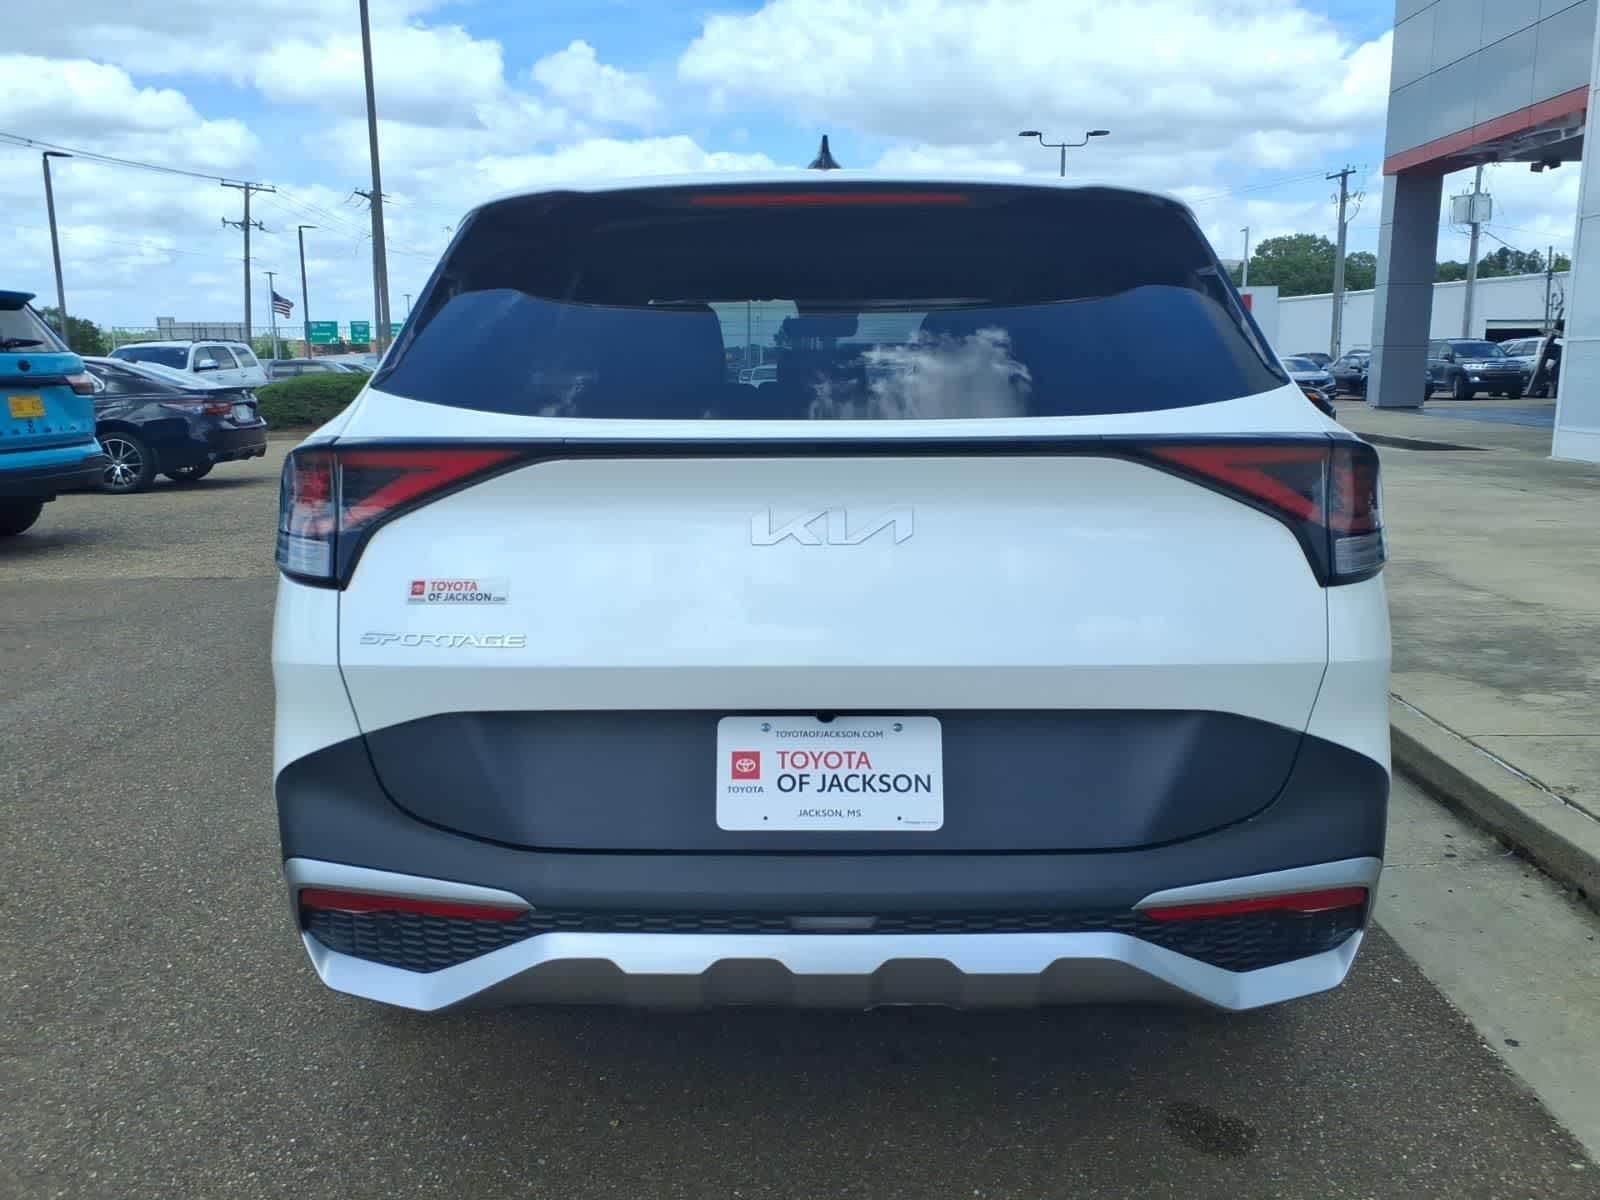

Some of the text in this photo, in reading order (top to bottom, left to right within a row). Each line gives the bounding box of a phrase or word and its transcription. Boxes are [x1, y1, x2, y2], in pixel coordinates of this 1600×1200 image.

[751, 505, 914, 546] KIA
[431, 581, 478, 591] TOYOTA
[428, 593, 442, 601] OF
[360, 632, 526, 648] SPORTAGE
[775, 730, 884, 739] TOYOTAOFJACKSON.COM
[776, 751, 872, 770] TOYOTA
[777, 774, 932, 793] OF JACKSON
[798, 809, 862, 818] JACKSON, MS
